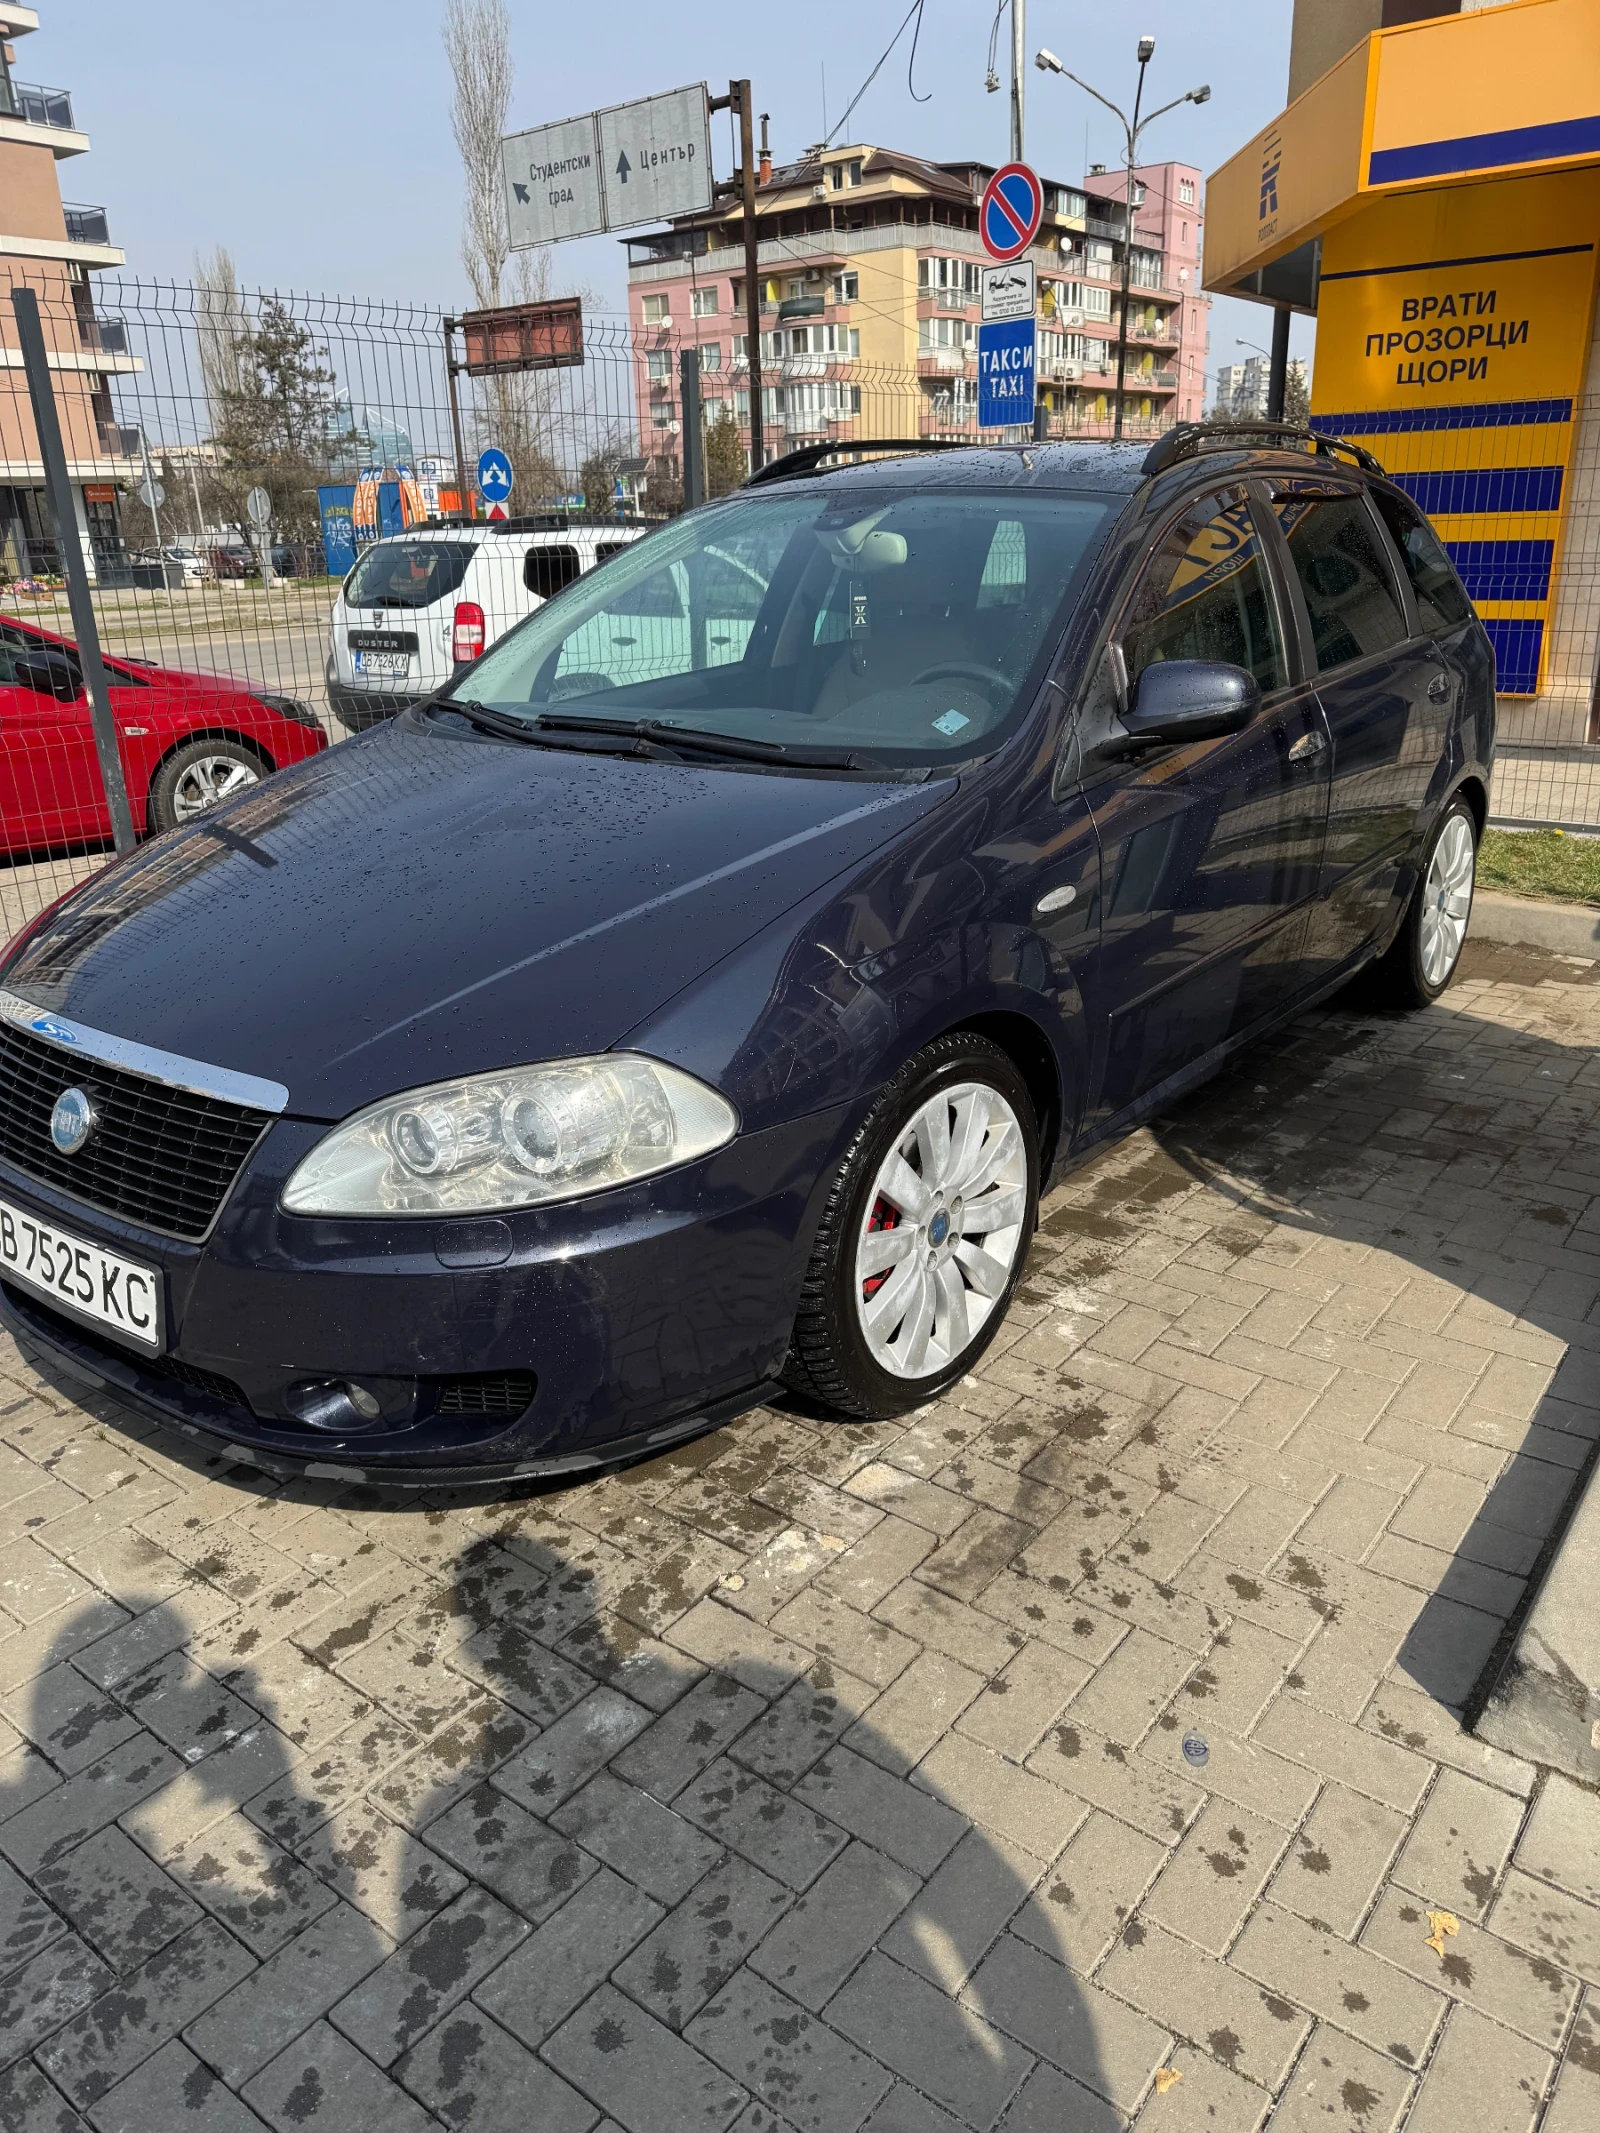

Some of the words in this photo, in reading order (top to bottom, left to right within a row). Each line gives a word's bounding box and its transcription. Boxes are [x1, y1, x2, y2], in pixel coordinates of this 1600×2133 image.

[529, 154, 591, 183] Студентски
[640, 142, 695, 171] Център
[548, 187, 574, 208] град
[1401, 290, 1497, 322] ВРАТИ
[1365, 320, 1529, 358] ПРОЗОРЦИ
[980, 346, 1033, 374] ТАКСИ
[1396, 356, 1488, 388] ЩОРИ
[990, 374, 1024, 398] TAXI
[358, 639, 398, 648] DUSTER
